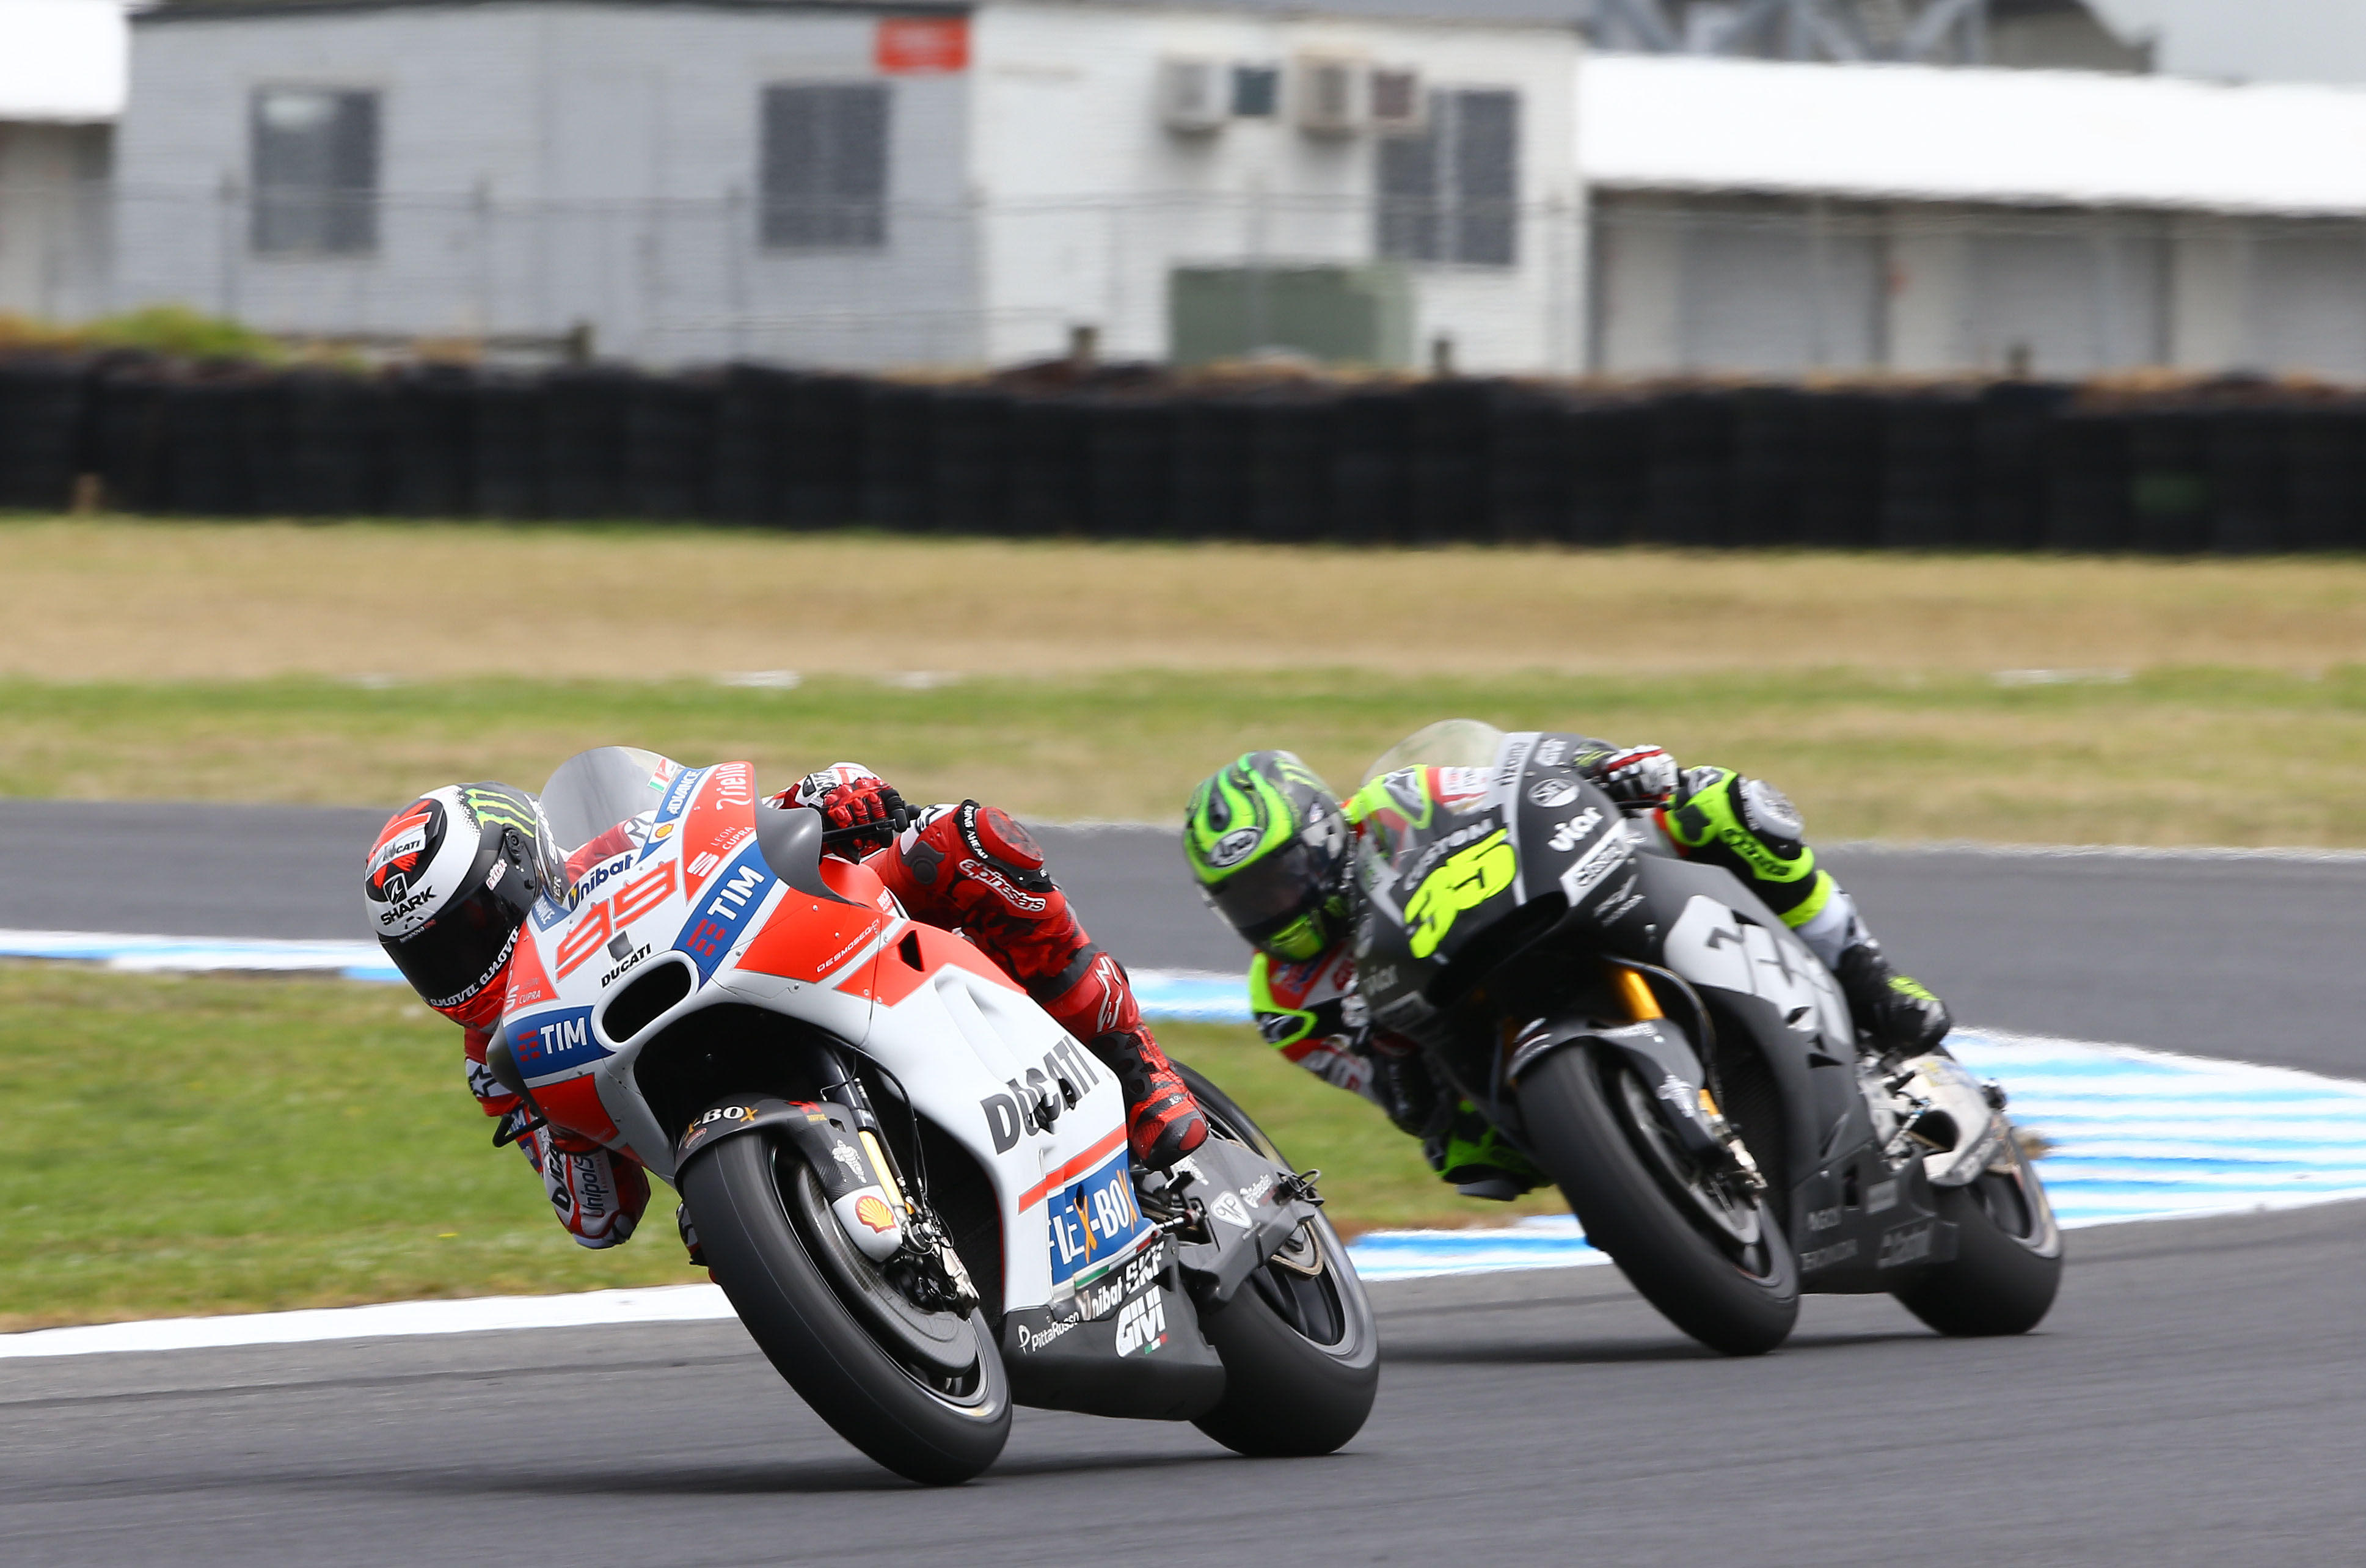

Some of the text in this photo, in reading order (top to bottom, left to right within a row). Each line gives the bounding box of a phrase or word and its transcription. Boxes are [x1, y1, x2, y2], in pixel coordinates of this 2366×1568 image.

[666, 770, 703, 815] ADVANCE
[716, 763, 747, 797] riello
[710, 826, 736, 847] LEON
[722, 826, 754, 850] CUPRA
[967, 830, 988, 859] AHEAD
[568, 855, 633, 910] Unibat
[707, 865, 765, 921] TIM
[1404, 827, 1517, 958] 35
[381, 885, 437, 926] SHARK
[556, 856, 678, 984] 99
[601, 943, 652, 988] DUCATI
[519, 990, 541, 1004] CUPRA
[540, 1018, 588, 1054] TIM
[980, 1035, 1100, 1156] DUCATI
[1125, 1241, 1165, 1294] SKF
[1075, 1276, 1123, 1321] Unibat
[1031, 1311, 1079, 1352] PittaRosso
[1115, 1285, 1166, 1358] GIVI
